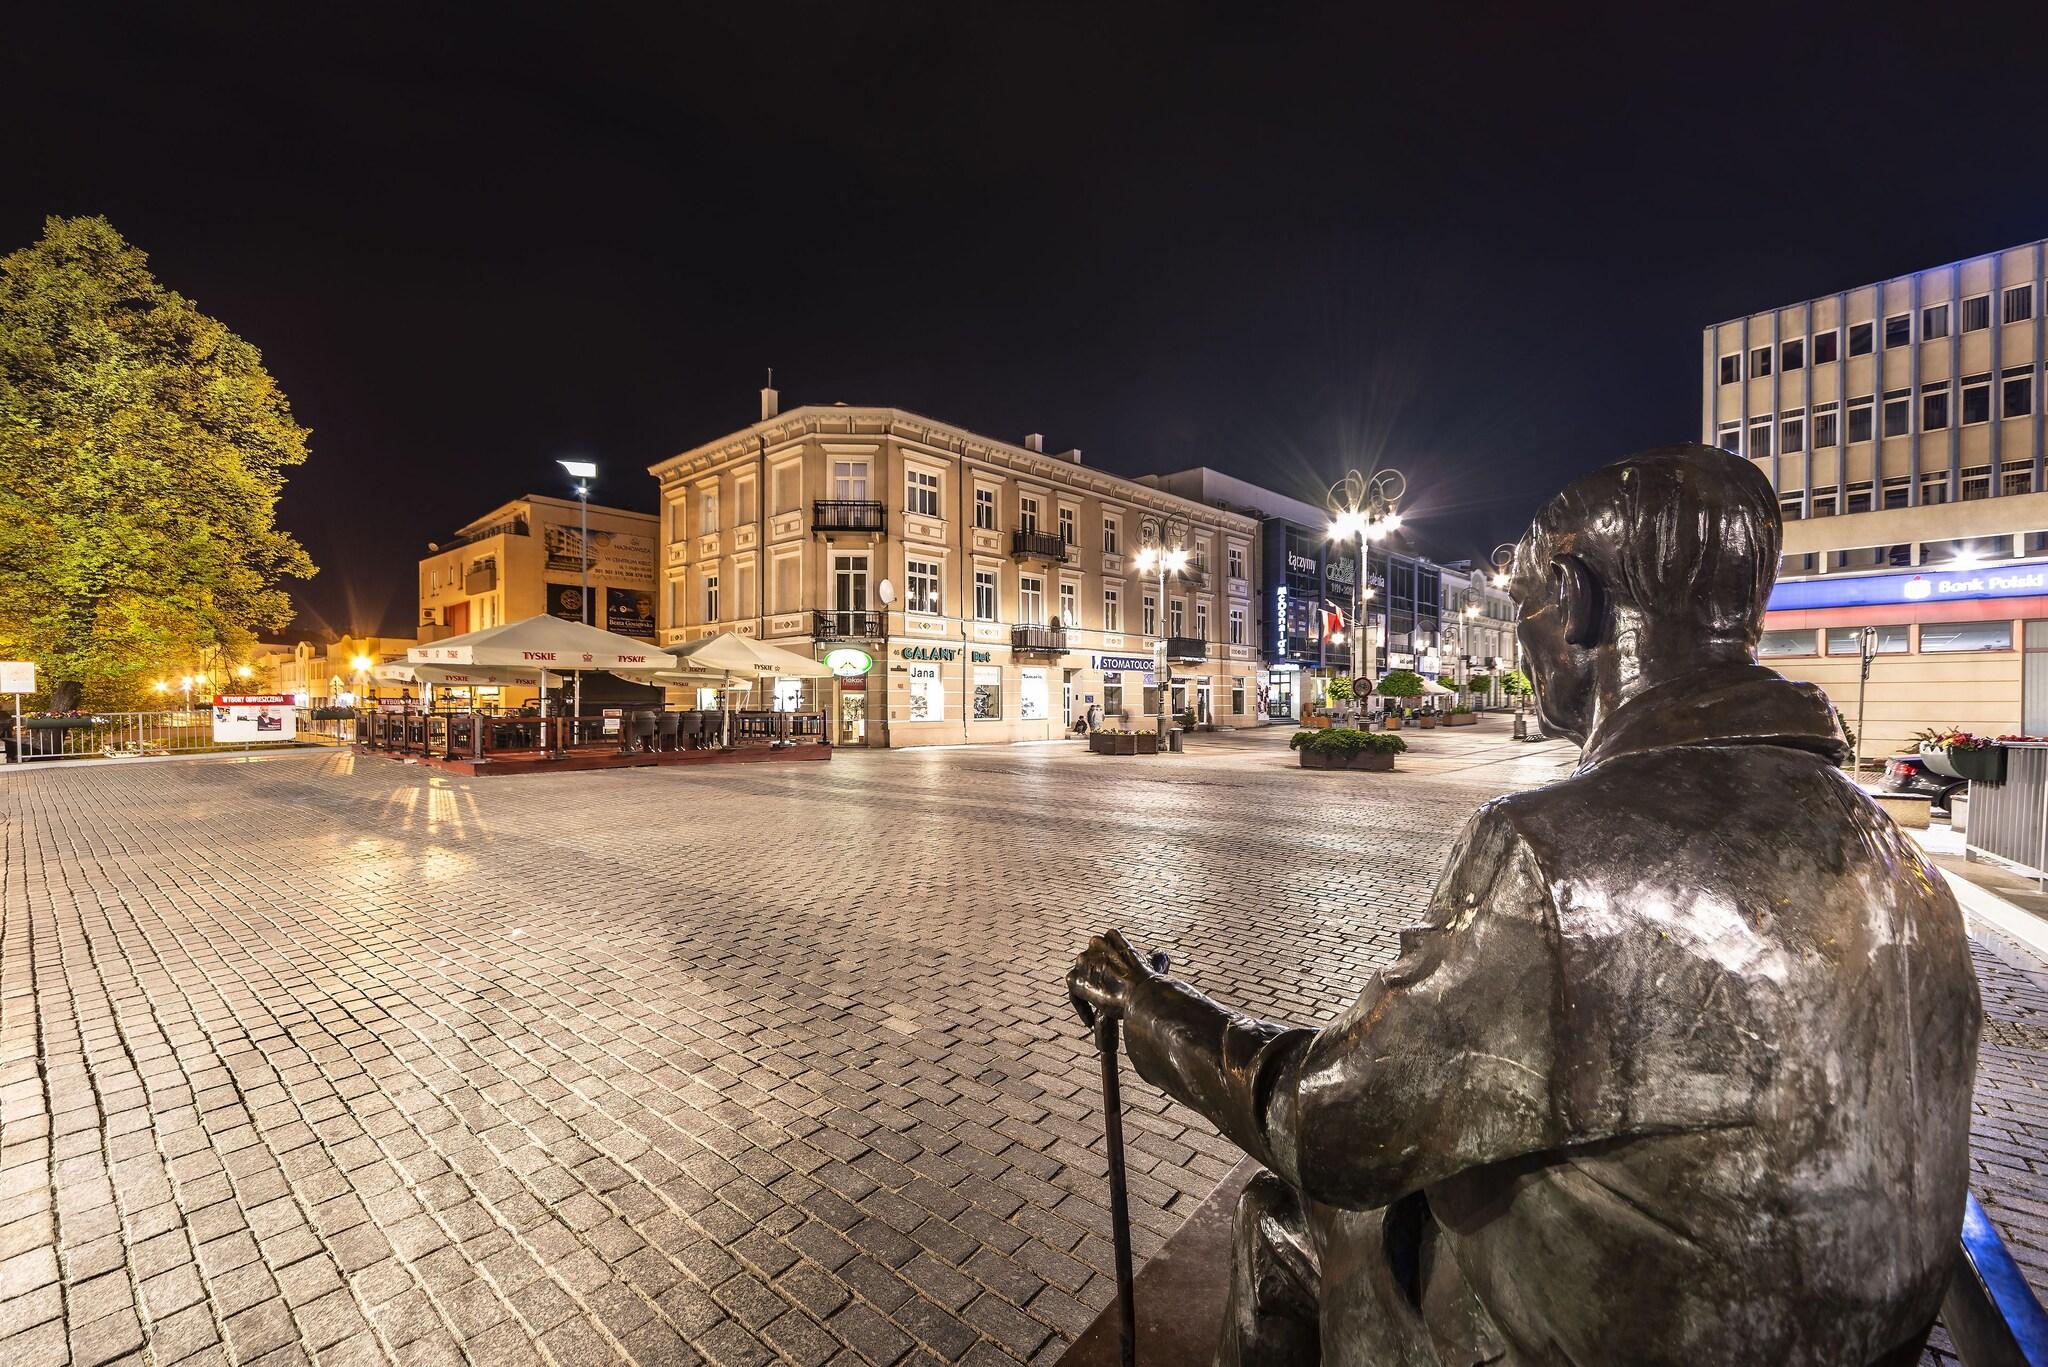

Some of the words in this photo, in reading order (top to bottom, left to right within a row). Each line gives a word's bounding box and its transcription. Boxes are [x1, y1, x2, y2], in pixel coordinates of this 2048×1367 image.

[1288, 551, 1317, 574] Łączymy
[1939, 578, 1984, 593] Bank
[1989, 573, 2044, 590] Polski
[522, 651, 557, 661] TYSKIE
[902, 646, 956, 661] GALANT
[617, 655, 647, 663] TYSKIE
[753, 663, 774, 671] TYSKIE
[911, 667, 935, 678] Jana
[515, 678, 537, 686] TYSKIE
[222, 695, 244, 703] WYBORY
